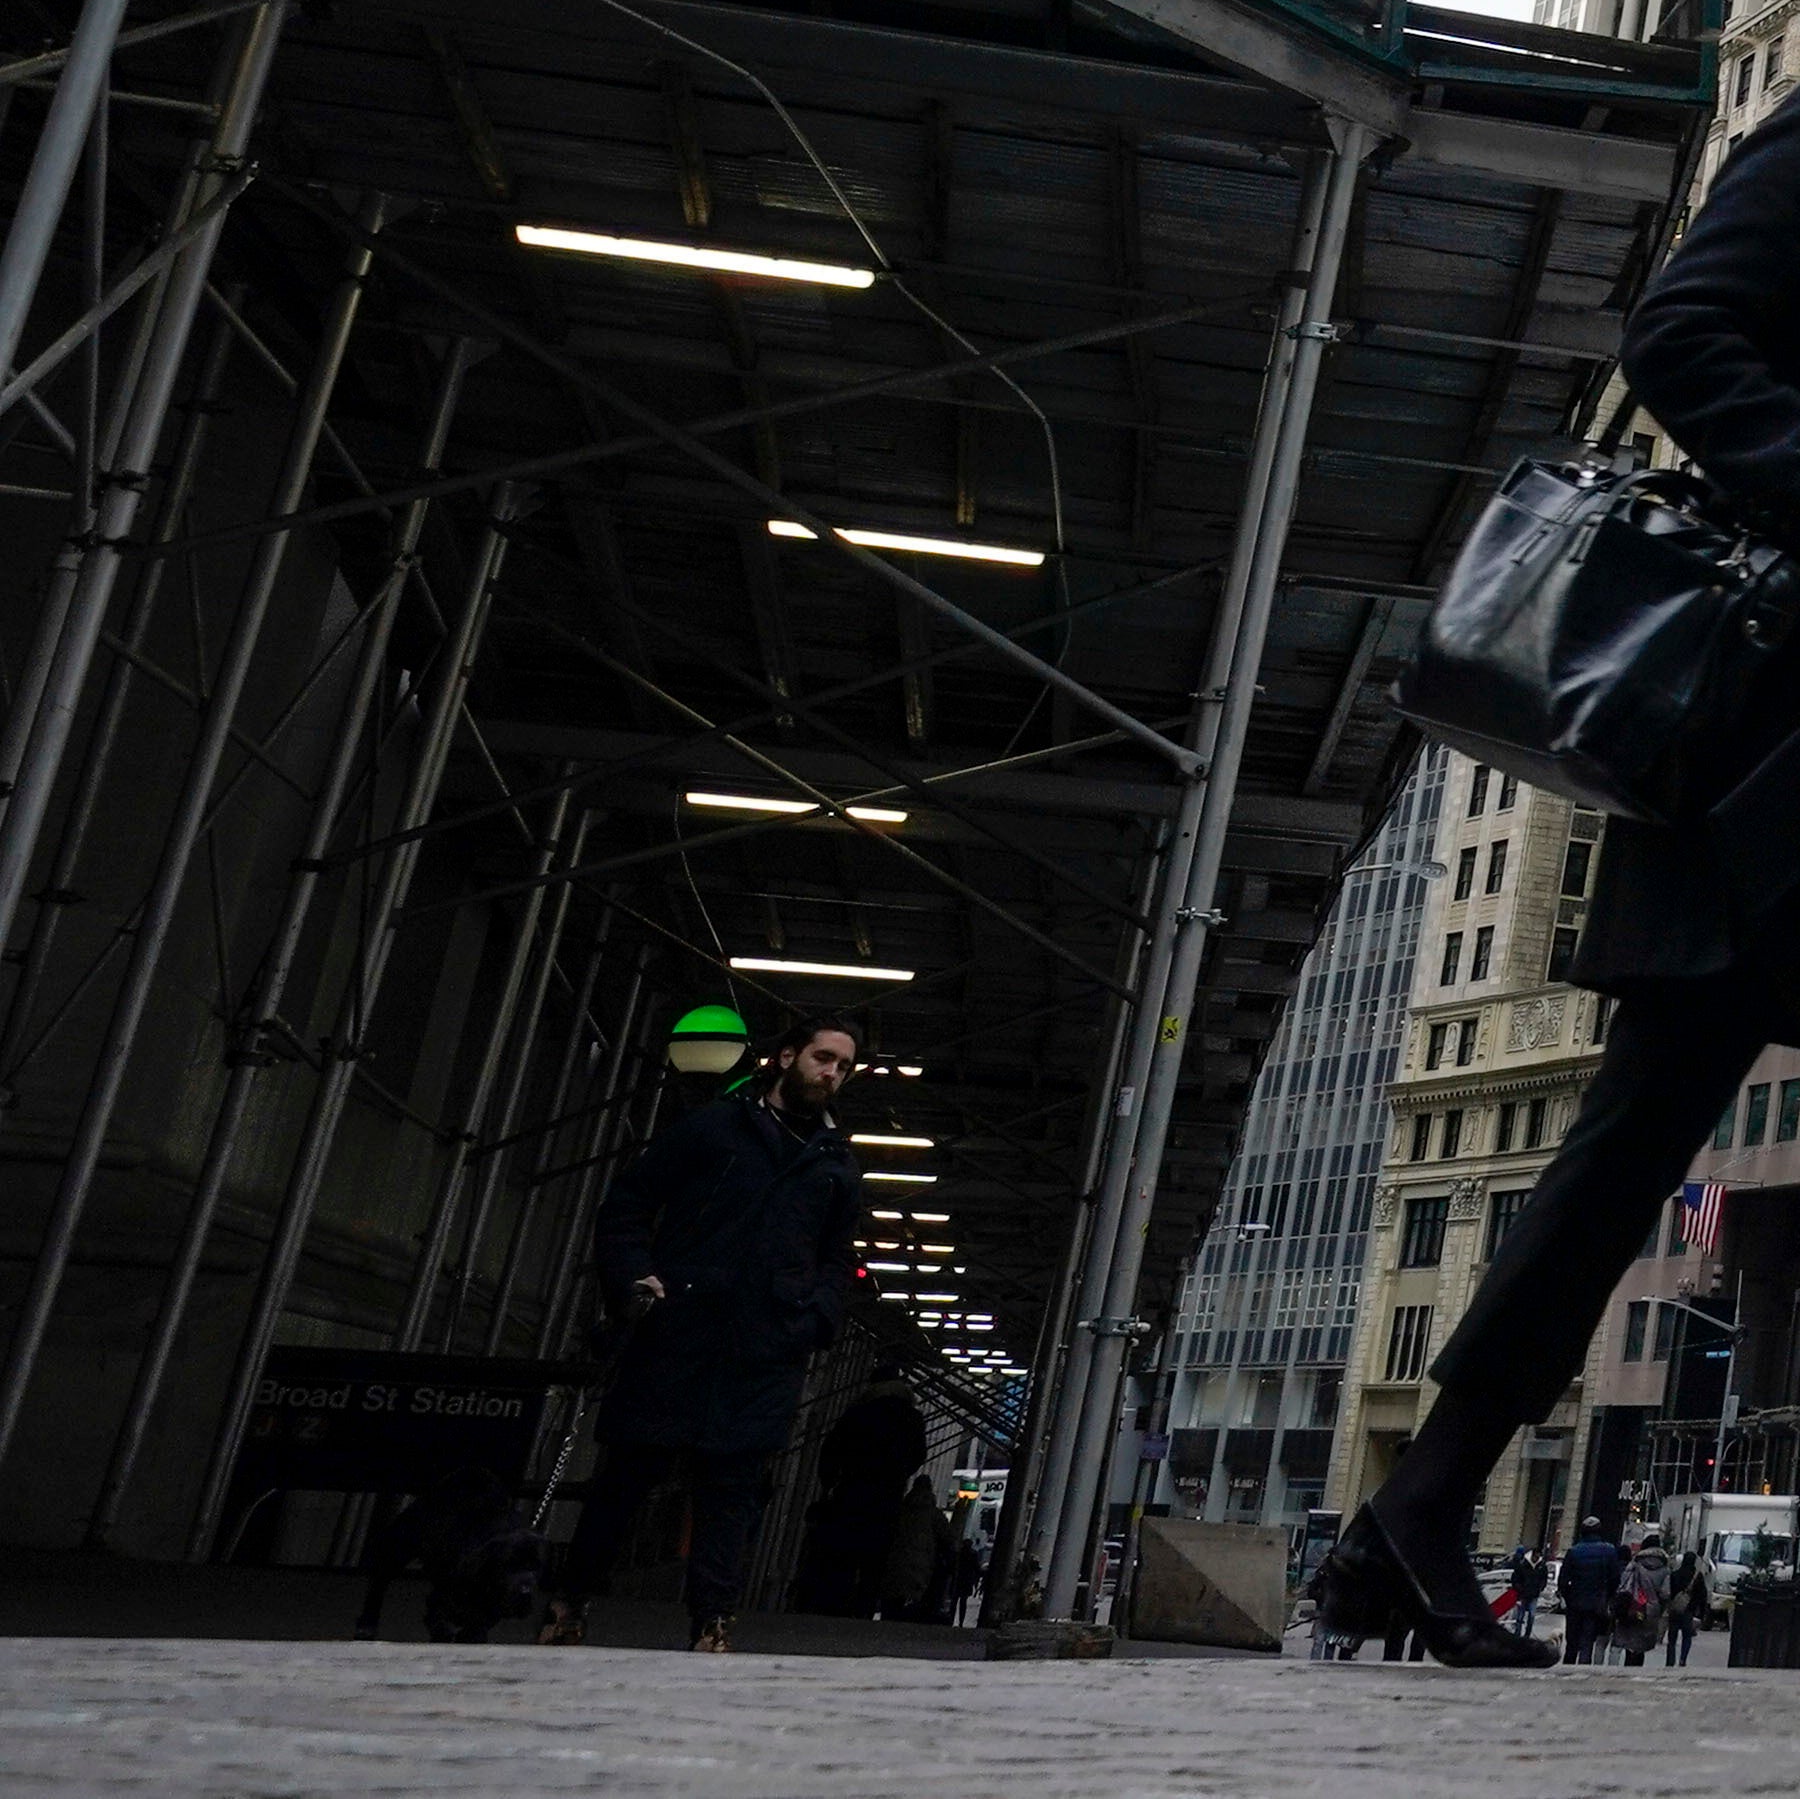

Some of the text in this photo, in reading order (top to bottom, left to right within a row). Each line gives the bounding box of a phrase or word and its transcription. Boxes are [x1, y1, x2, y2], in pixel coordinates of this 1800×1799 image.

[255, 1378, 522, 1418] Broad St Station
